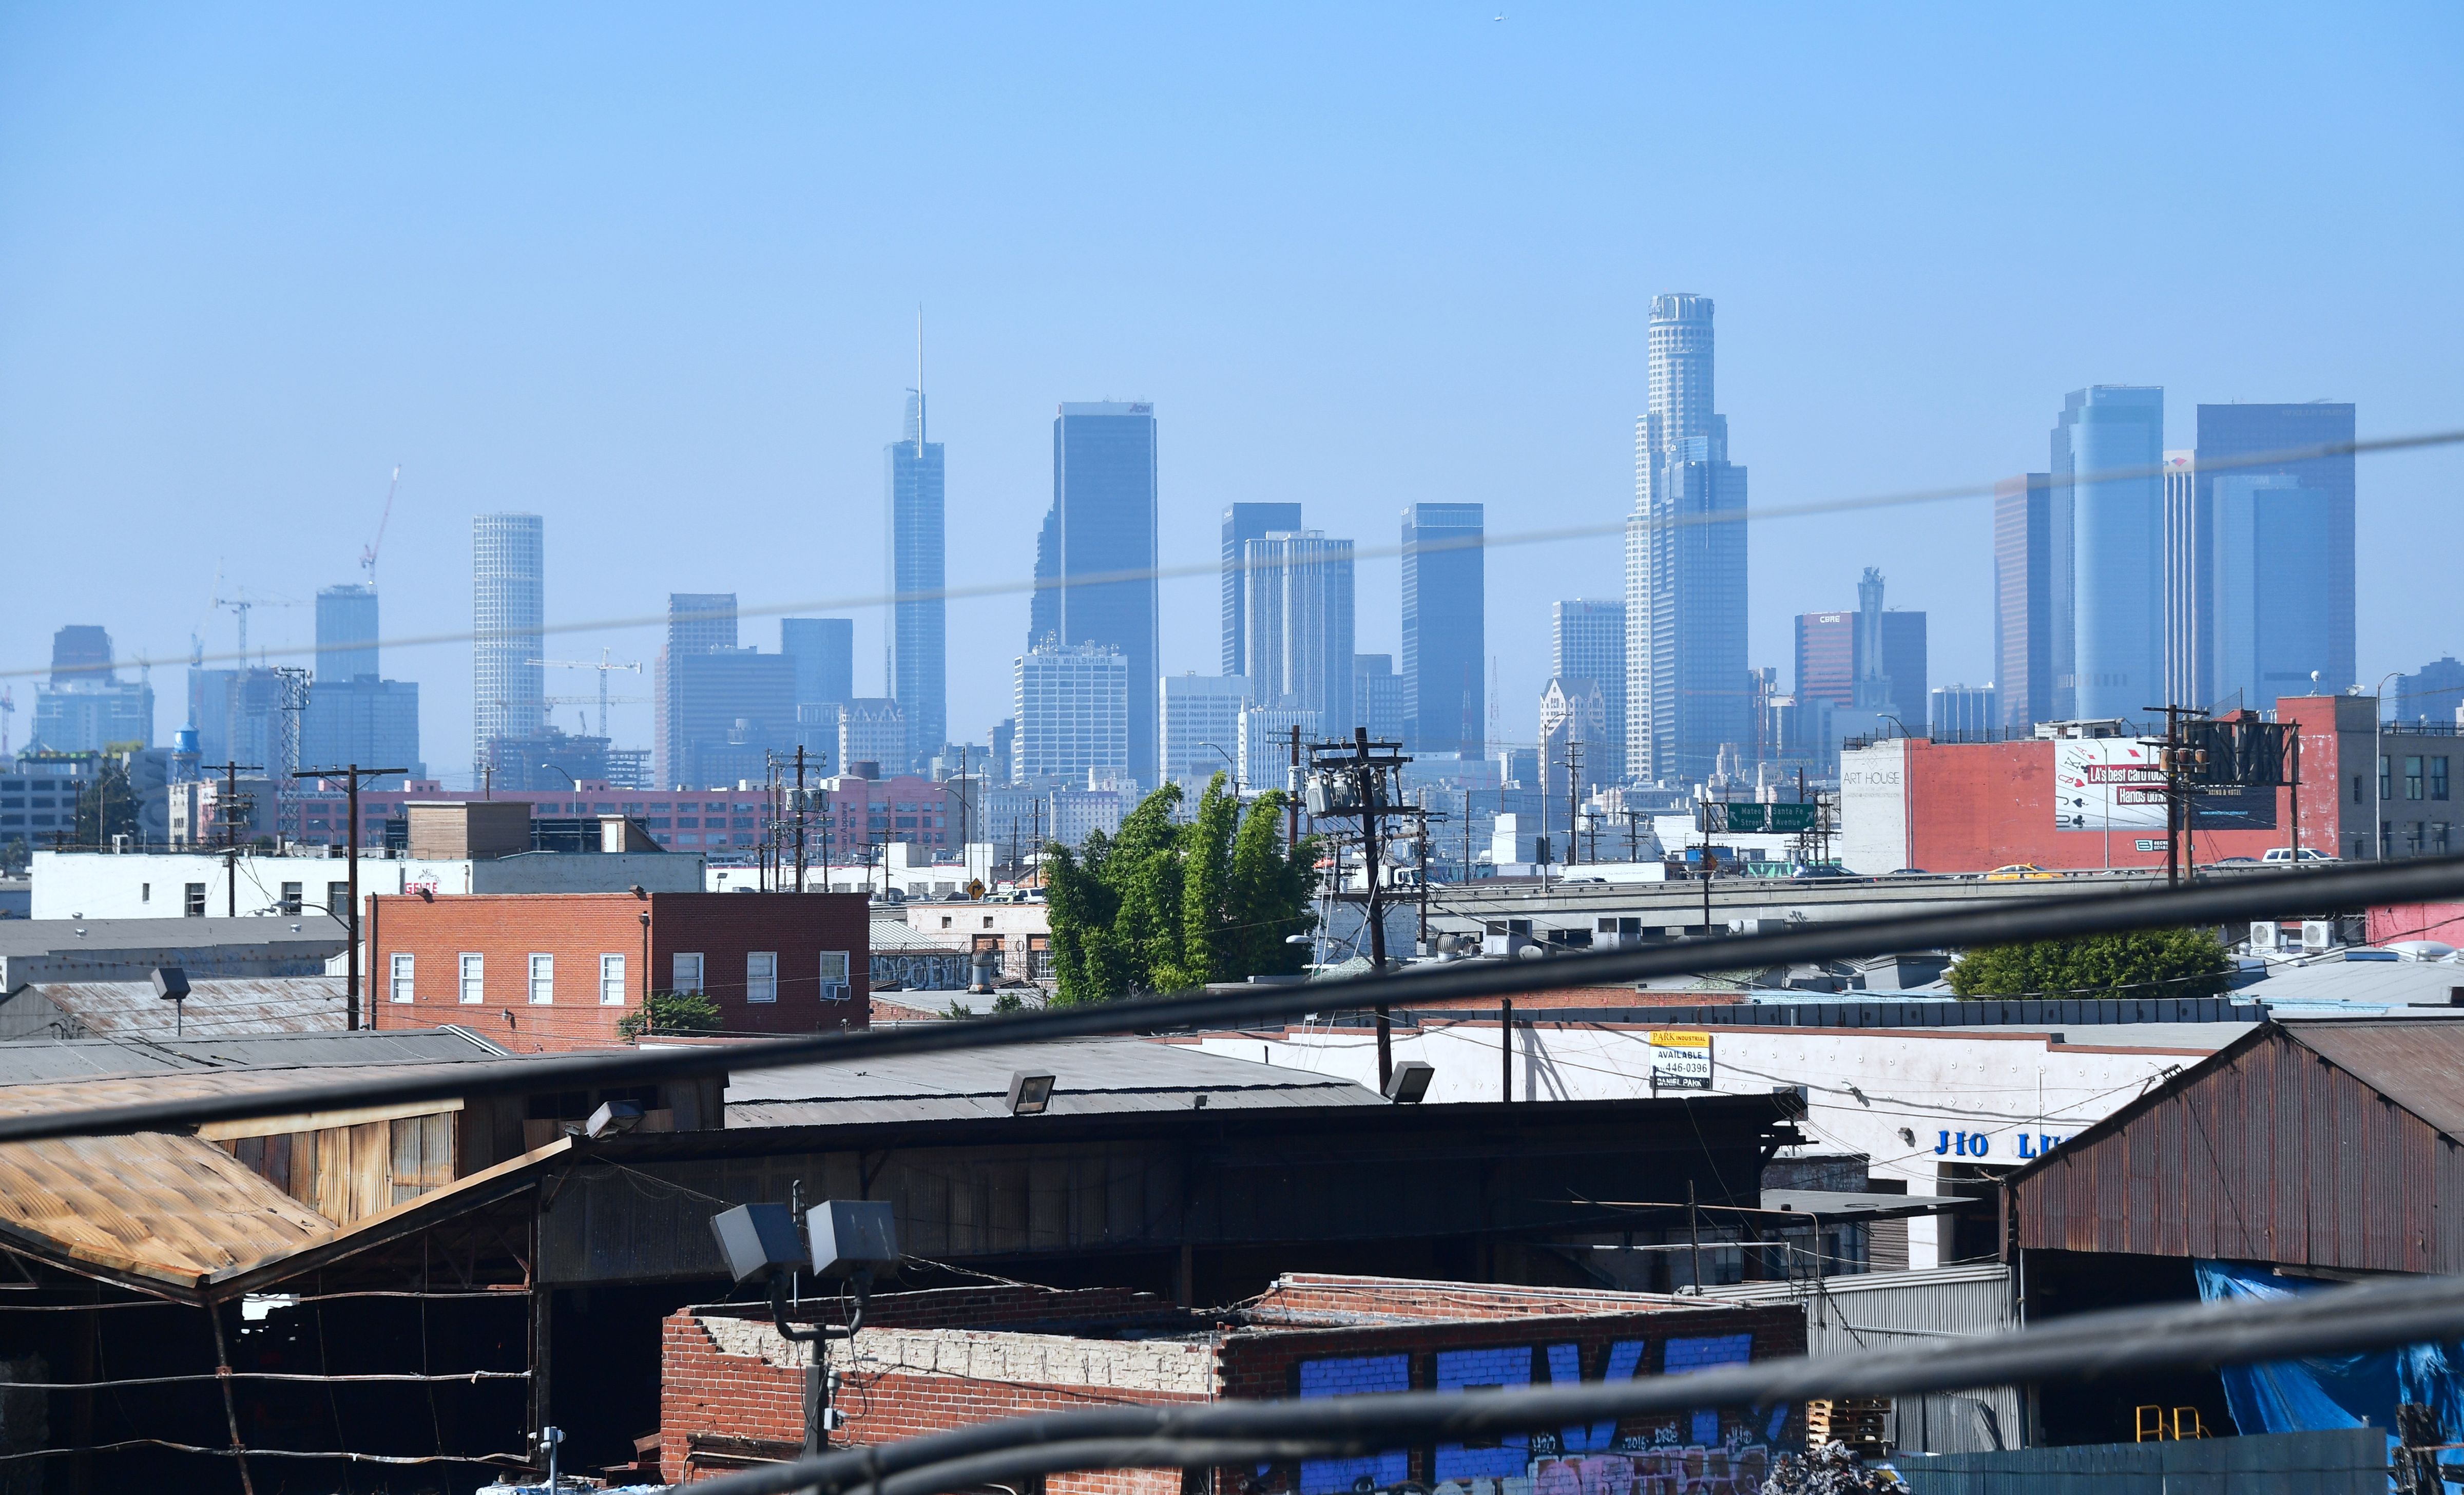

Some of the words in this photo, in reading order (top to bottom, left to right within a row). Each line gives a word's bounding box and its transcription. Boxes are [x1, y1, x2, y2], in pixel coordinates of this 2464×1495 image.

[1843, 772, 1862, 784] ART
[1865, 772, 1900, 784] HOUSE
[2090, 767, 2106, 782] LA's
[2108, 767, 2126, 782] best
[2119, 789, 2146, 803] Hands
[1652, 1032, 1675, 1041] PARK
[1658, 1051, 1702, 1059] AVAILABLE
[1683, 1079, 1702, 1087] PARK
[1935, 1130, 1989, 1157] JIO
[2017, 1133, 2076, 1159] LU
